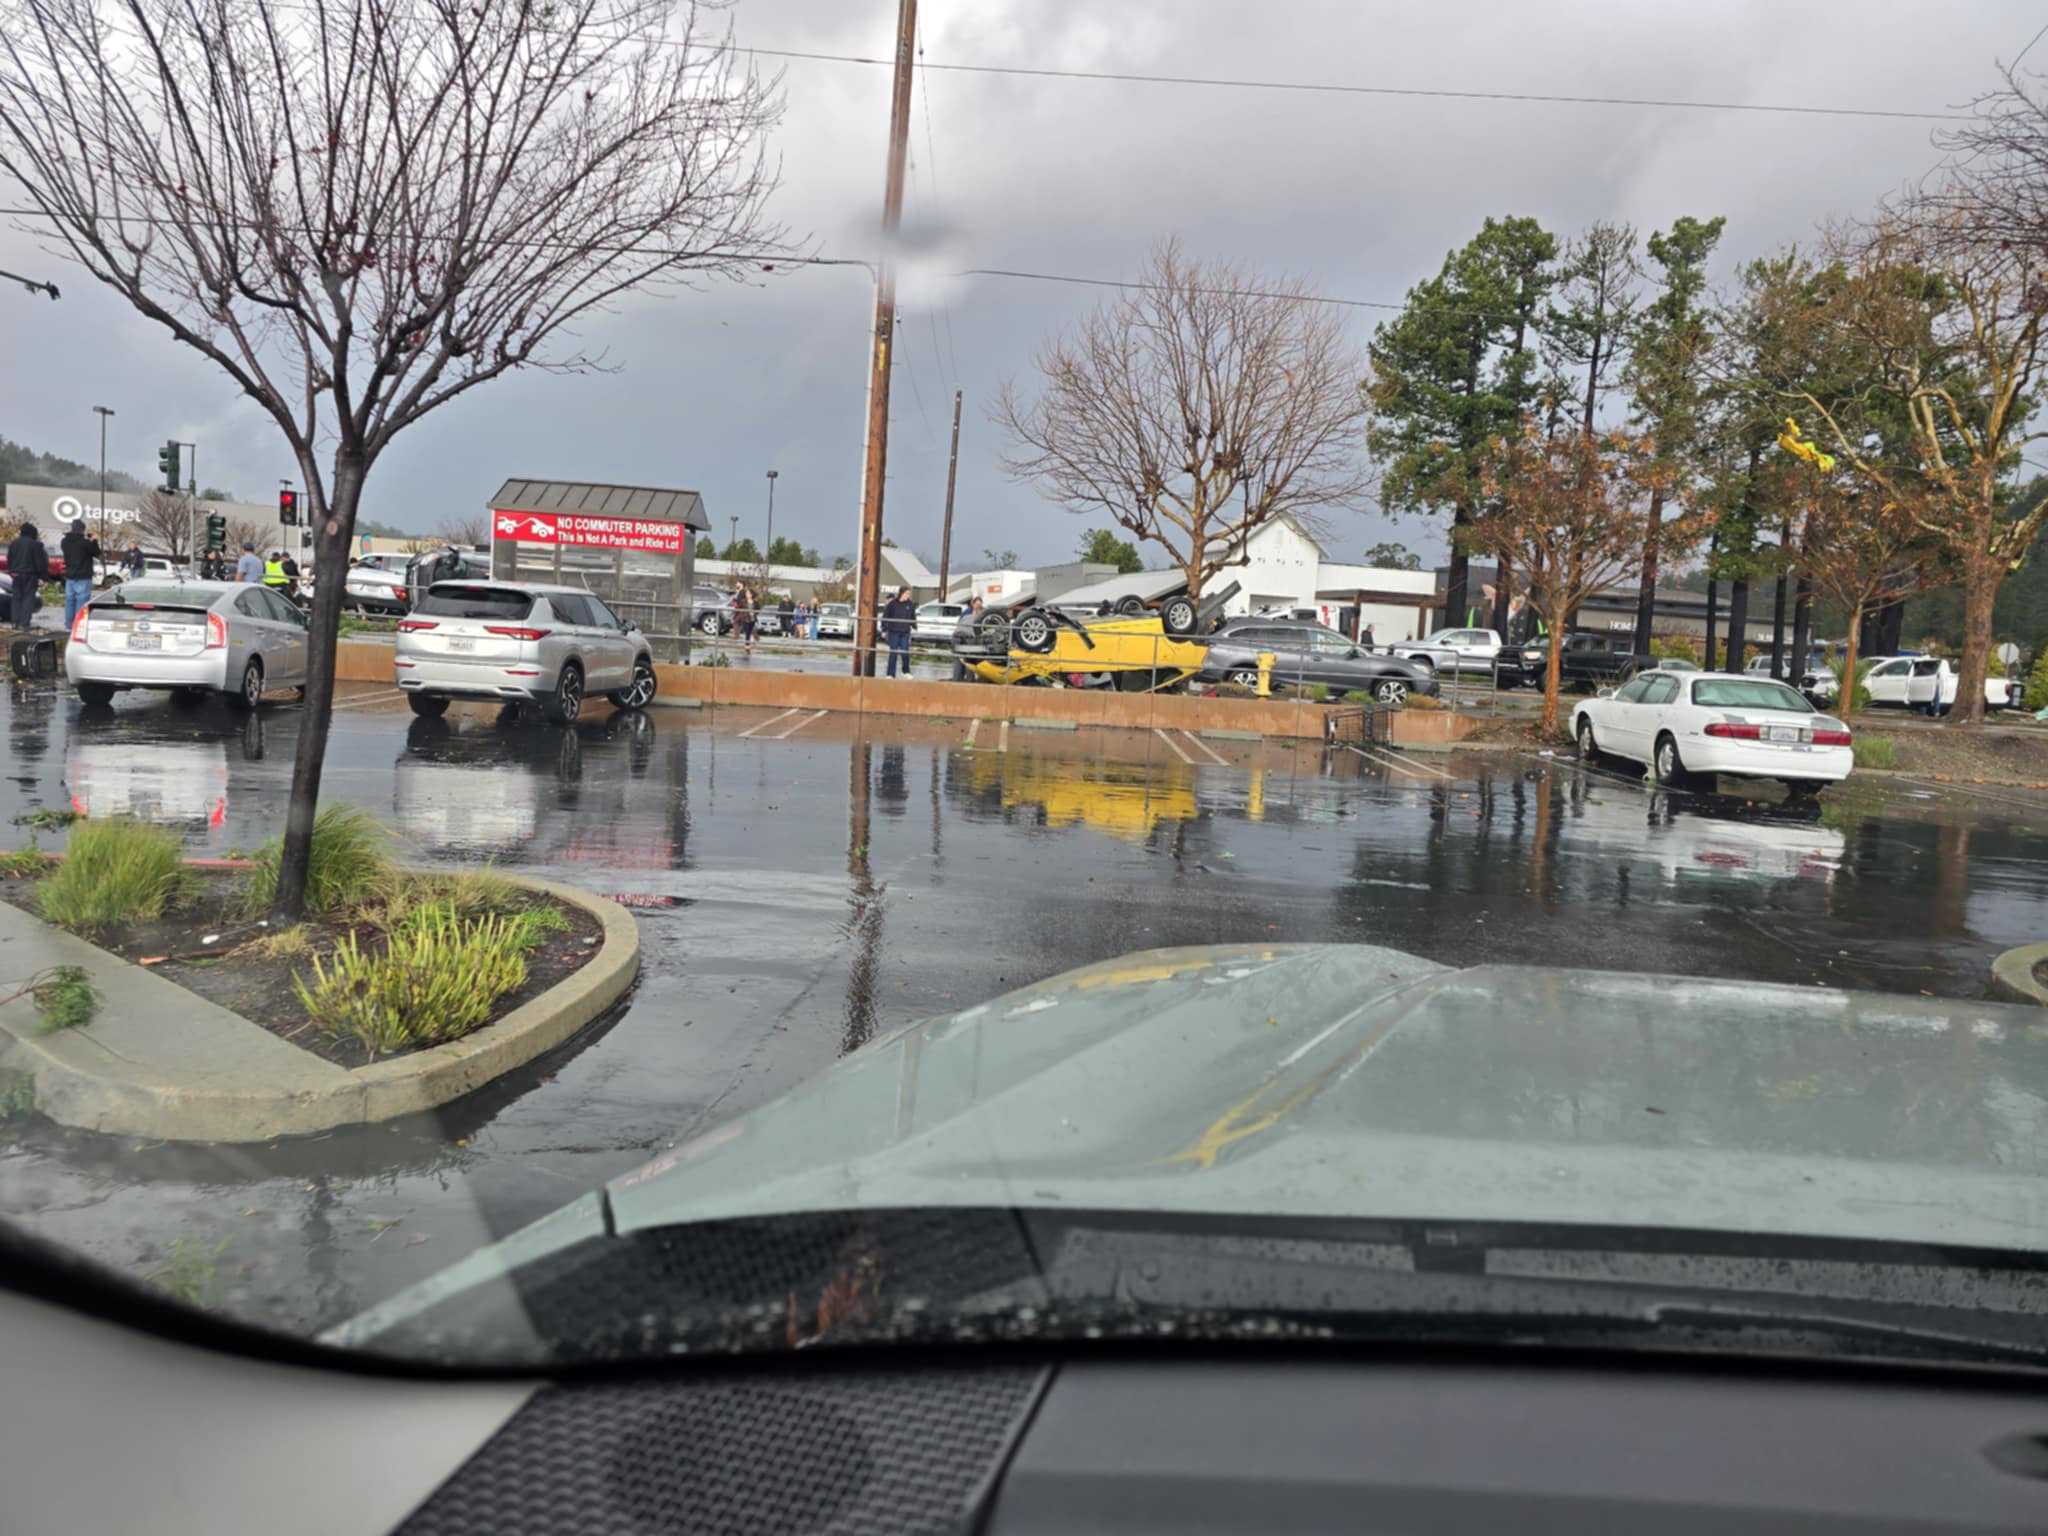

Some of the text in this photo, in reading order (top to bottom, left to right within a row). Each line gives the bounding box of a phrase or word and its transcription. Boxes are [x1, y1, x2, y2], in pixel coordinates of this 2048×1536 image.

[85, 503, 142, 524] target
[557, 517, 680, 537] NO COMMUTER PARKING
[557, 530, 575, 543] This
[585, 533, 600, 544] Not
[600, 534, 608, 545] A
[609, 535, 627, 546] Park
[630, 537, 644, 547] and
[646, 538, 665, 549] Ride
[666, 539, 679, 550] Lot
